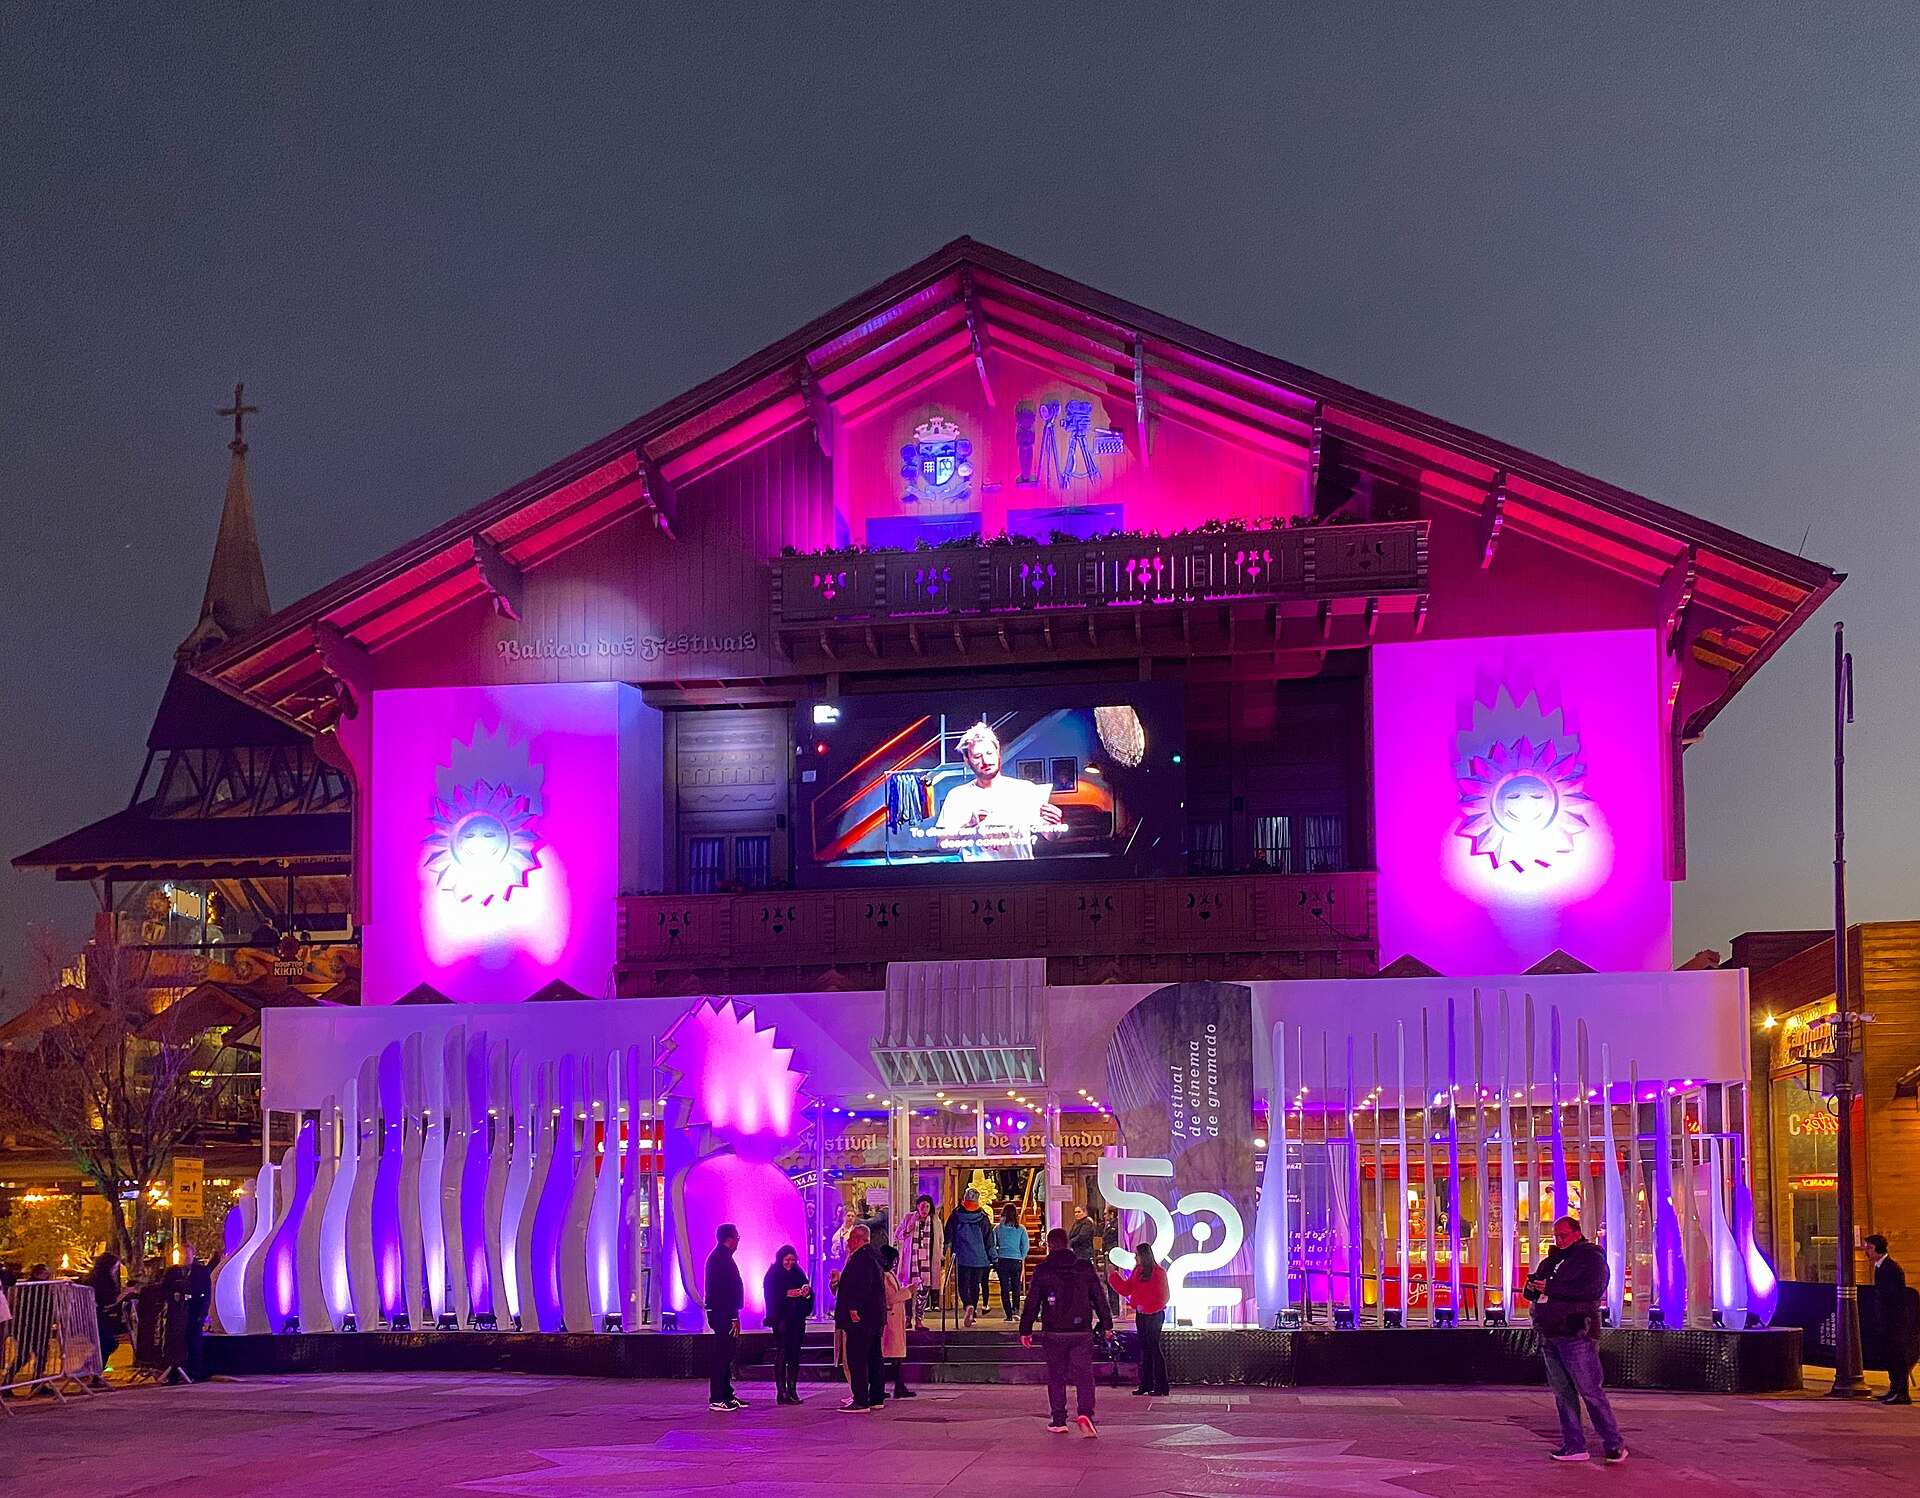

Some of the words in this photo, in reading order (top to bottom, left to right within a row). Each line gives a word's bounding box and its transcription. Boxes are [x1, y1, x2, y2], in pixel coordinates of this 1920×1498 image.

[598, 634, 636, 656] dos
[1188, 1040, 1200, 1108] cinema
[1204, 1023, 1220, 1108] gramado
[1171, 1065, 1187, 1139] festival
[989, 1131, 1010, 1147] de
[1189, 1115, 1201, 1137] de
[1206, 1115, 1218, 1137] de
[1097, 1156, 1244, 1307] 52
